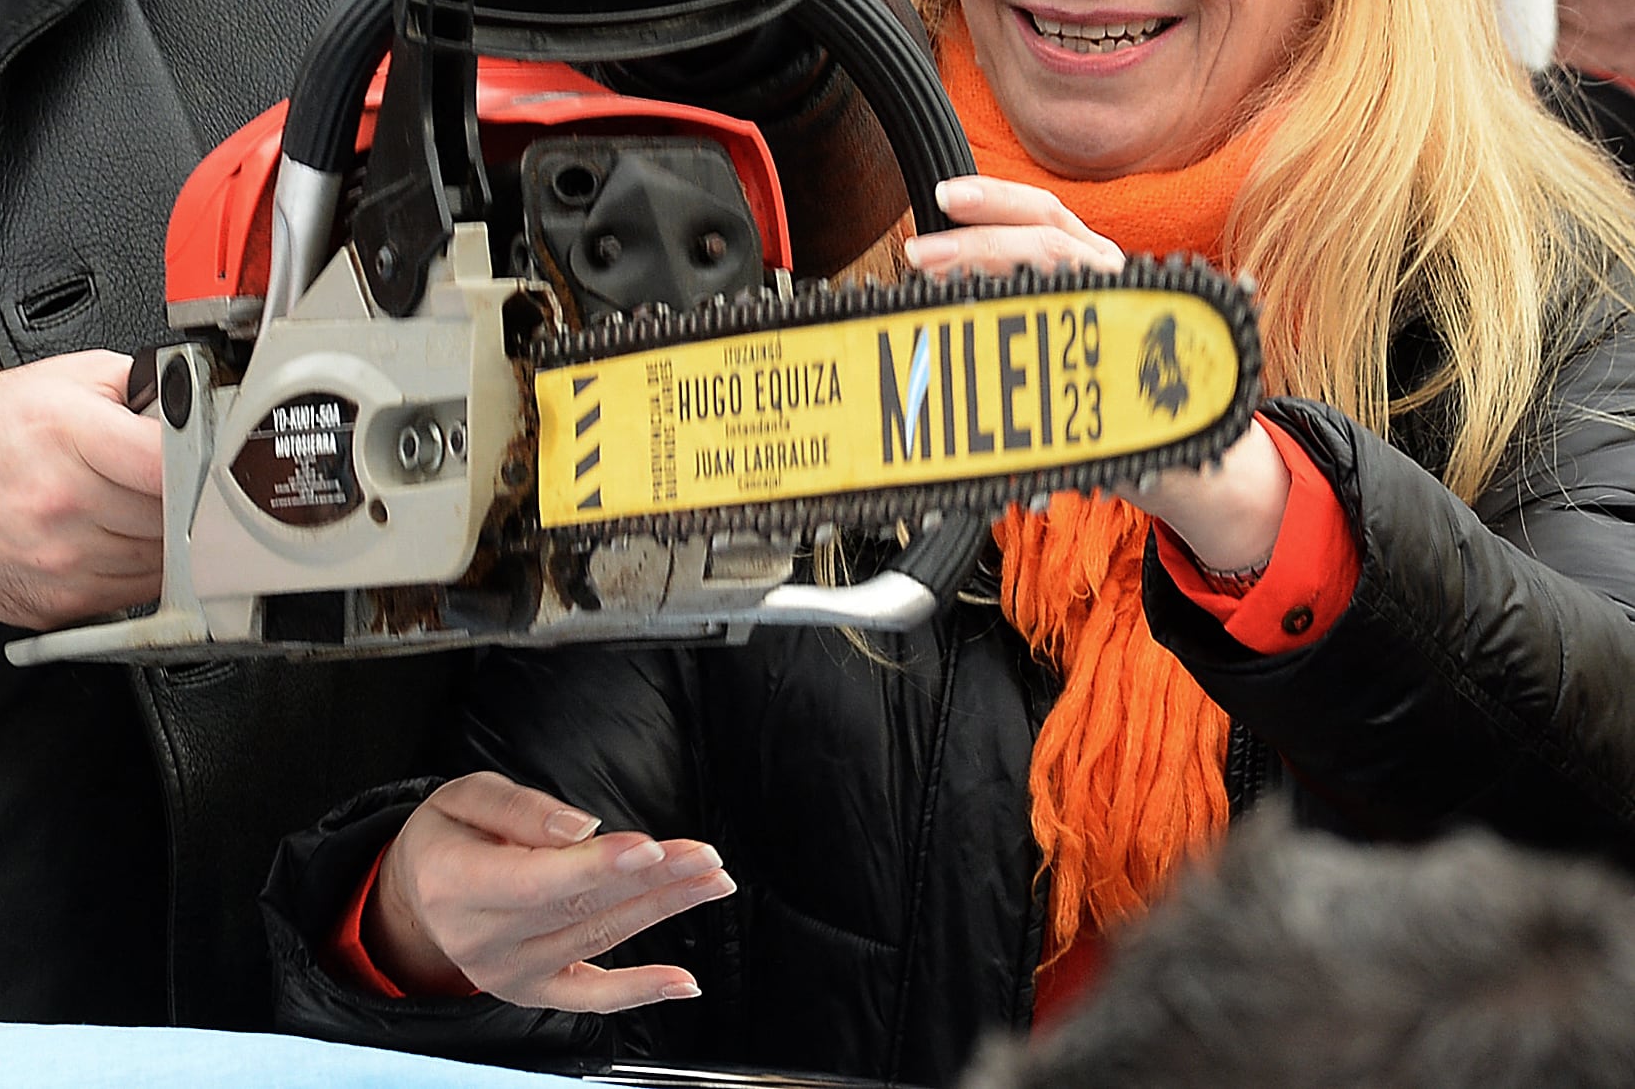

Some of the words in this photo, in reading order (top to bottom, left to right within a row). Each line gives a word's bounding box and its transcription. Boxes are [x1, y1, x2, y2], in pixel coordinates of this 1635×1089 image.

[1061, 305, 1100, 371] 20
[678, 372, 744, 423] HUGO
[754, 360, 842, 418] EQUIZA
[878, 310, 1053, 463] MILEI
[1064, 379, 1102, 443] 23
[275, 432, 338, 459] MOTOSIERRA
[695, 445, 736, 481] JUAN
[743, 435, 830, 473] LARRALDE
